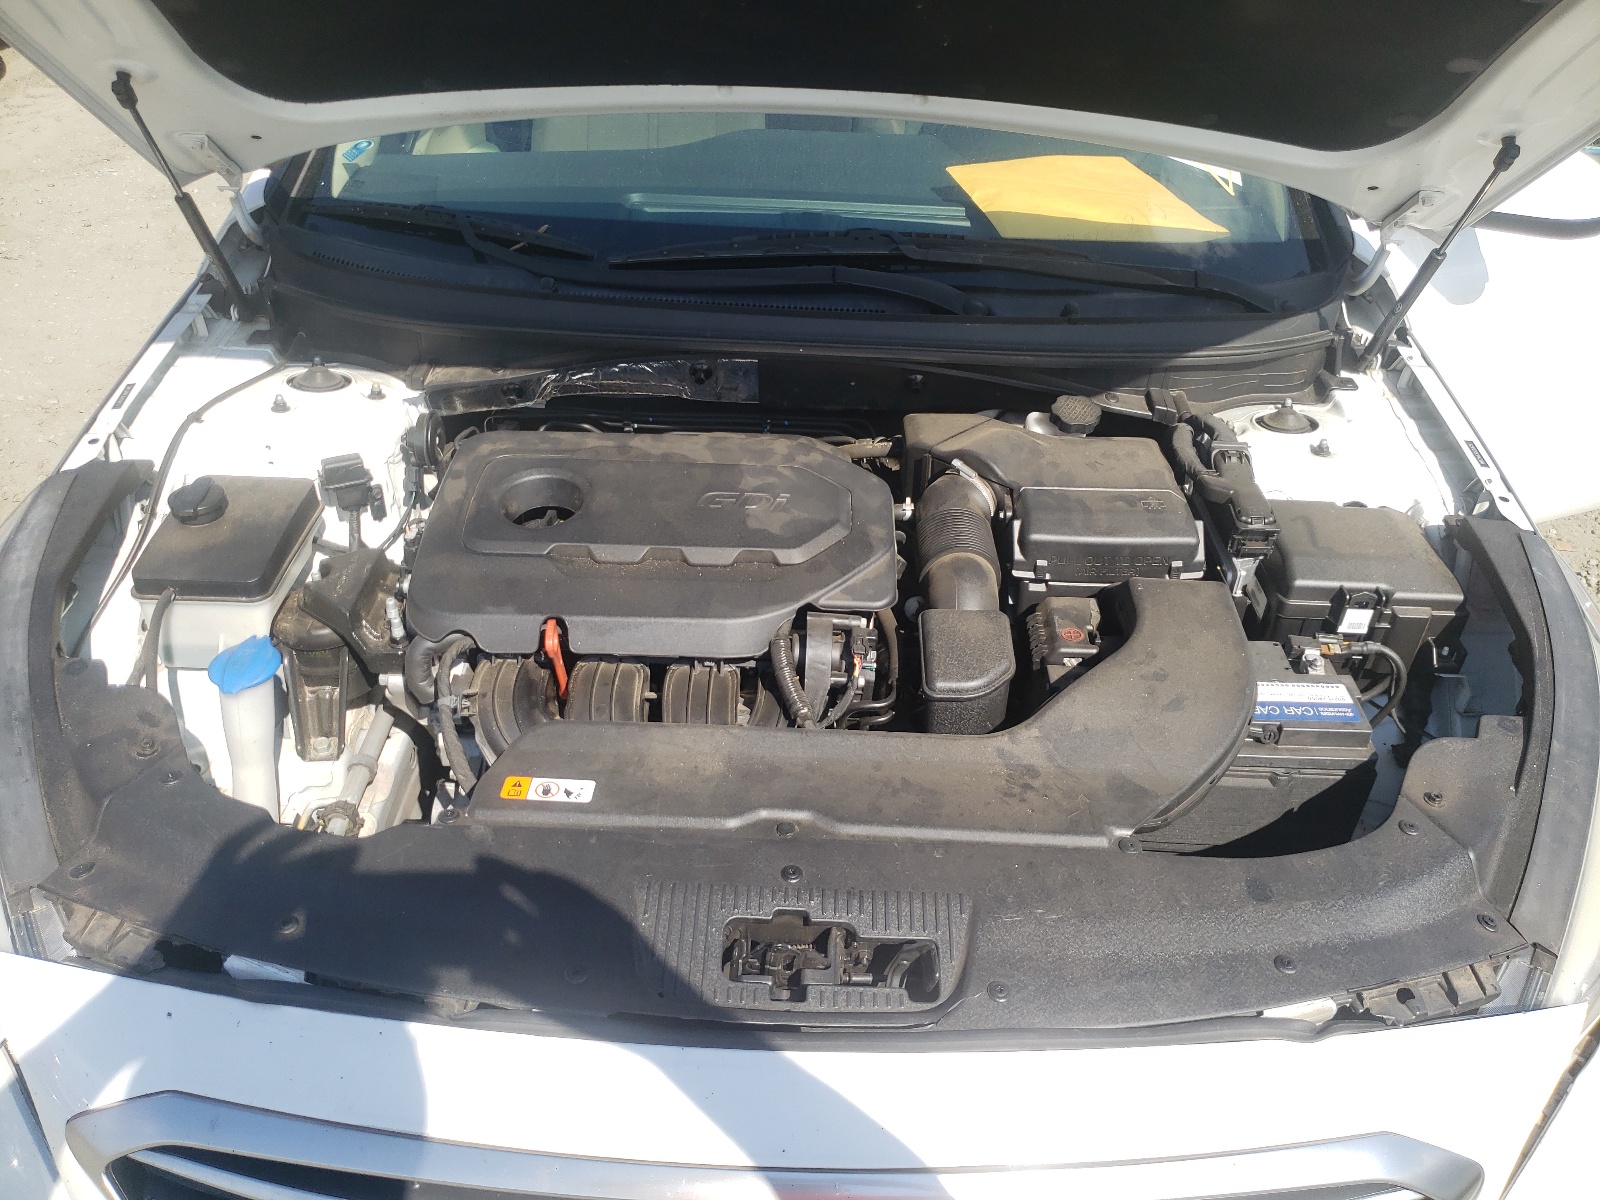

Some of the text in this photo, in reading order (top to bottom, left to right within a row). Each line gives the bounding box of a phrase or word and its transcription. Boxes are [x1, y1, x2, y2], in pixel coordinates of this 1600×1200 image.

[1048, 556, 1170, 567] PULL OUT TO OPEN
[1282, 705, 1314, 716] CAR
